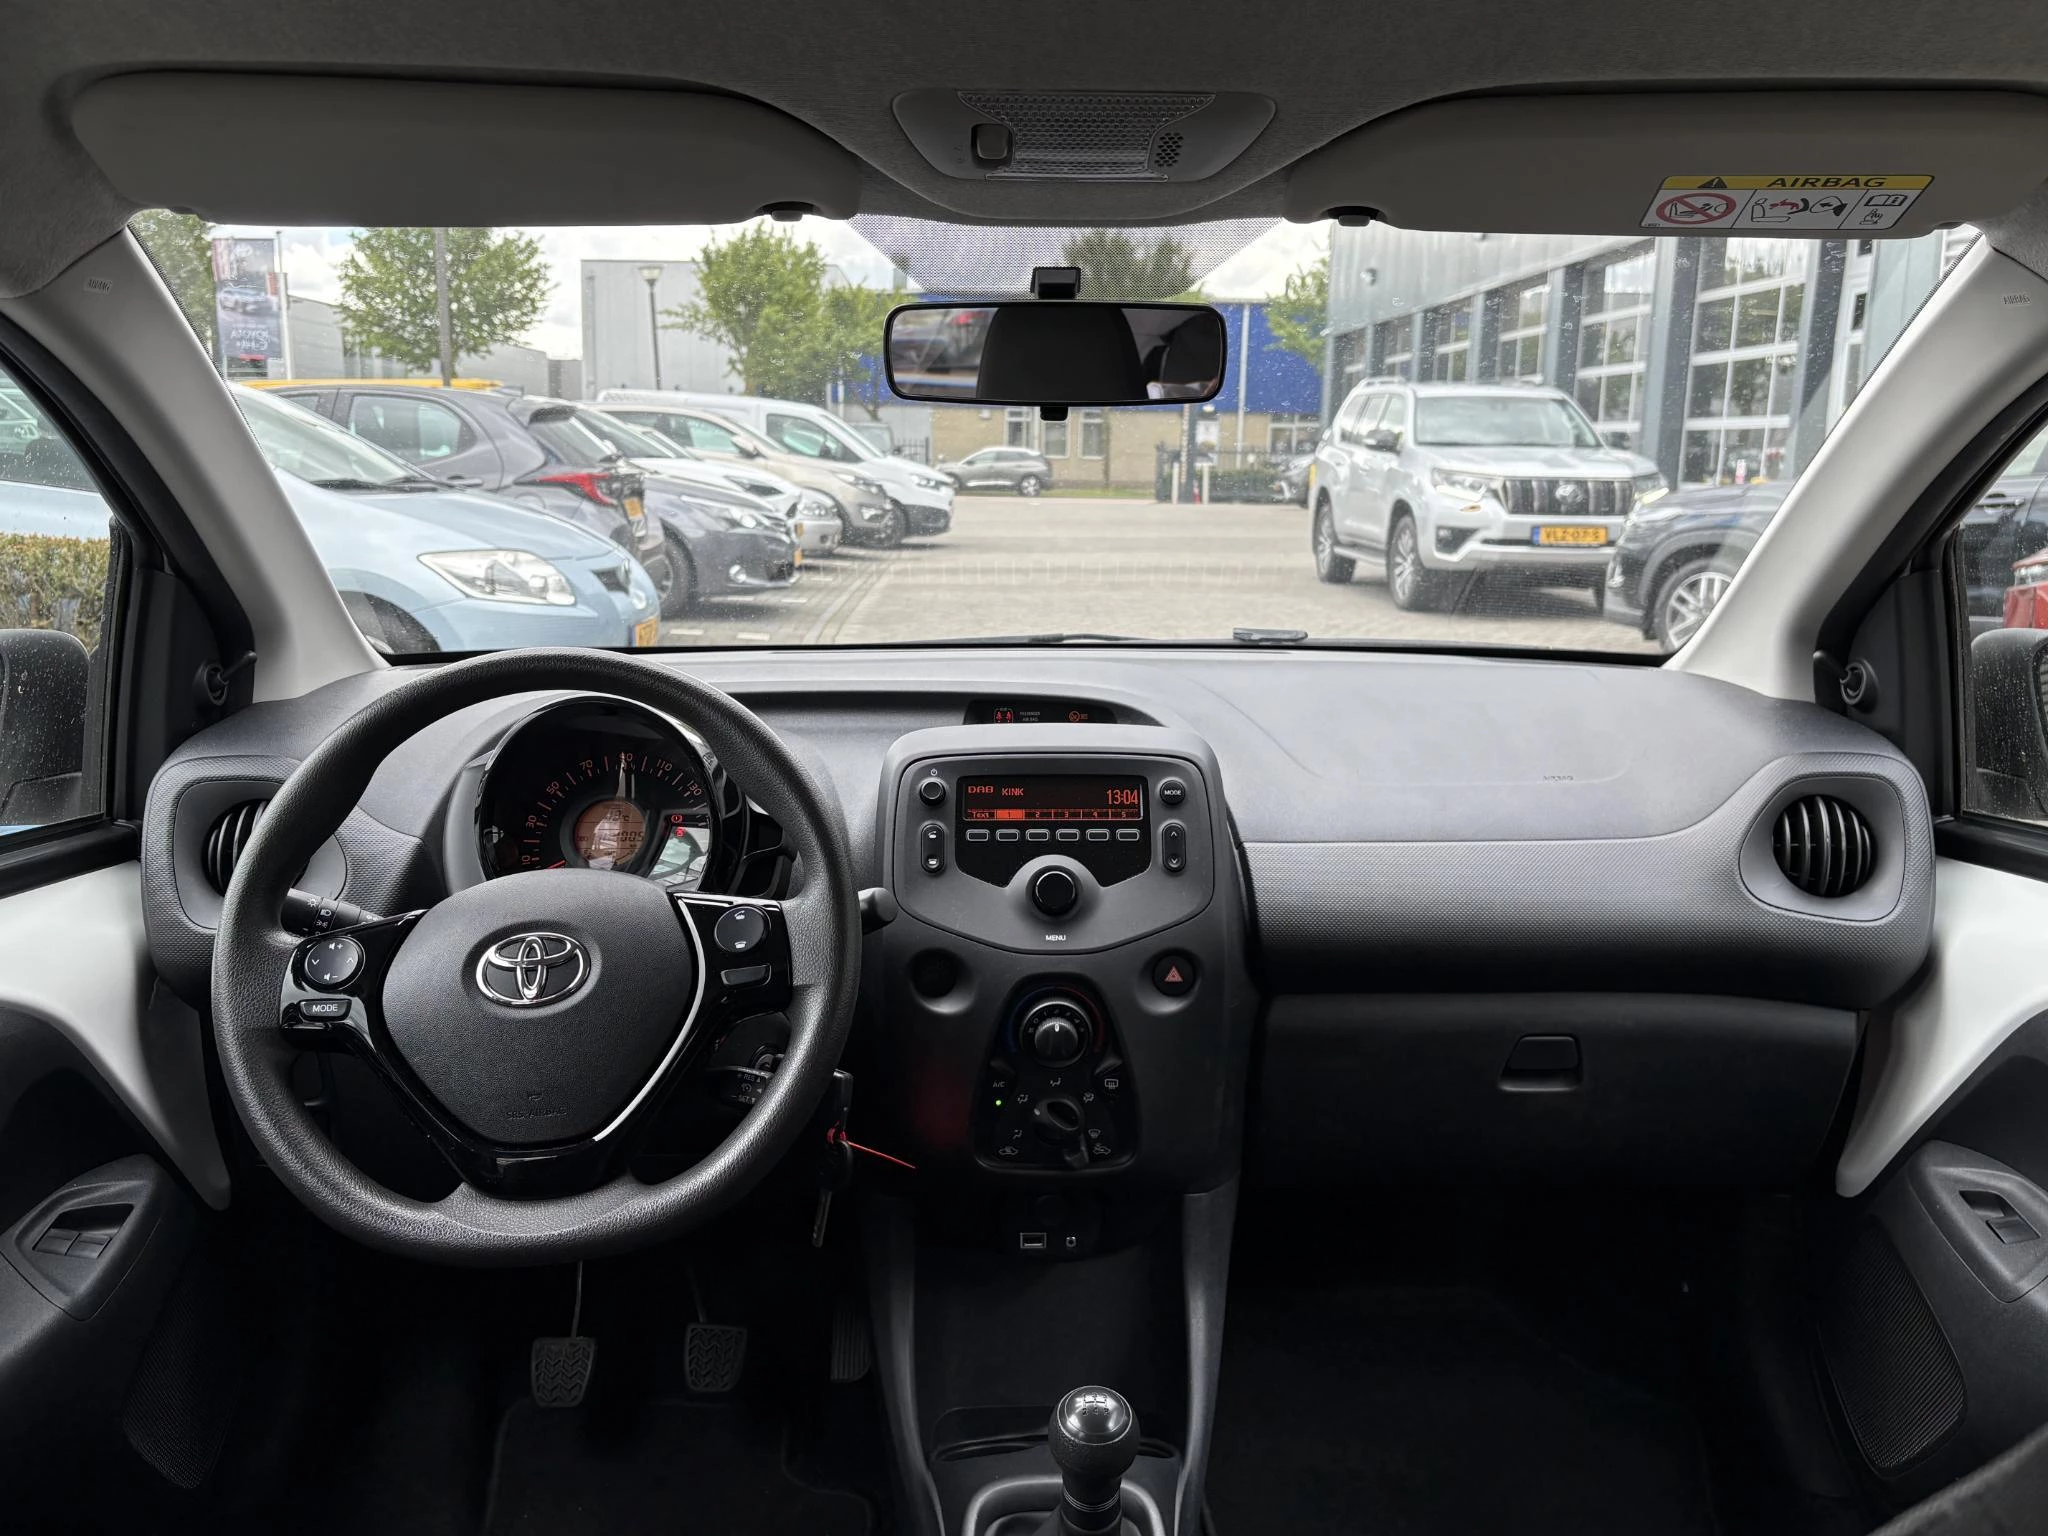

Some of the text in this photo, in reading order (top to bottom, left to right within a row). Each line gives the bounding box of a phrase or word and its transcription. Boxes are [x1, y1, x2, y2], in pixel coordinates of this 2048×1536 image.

[1766, 176, 1887, 188] AIRBAG
[578, 759, 593, 769] 70
[656, 759, 673, 771] 110
[546, 781, 560, 794] 50
[687, 779, 702, 796] 130
[967, 785, 1139, 805] DAB KINK 13:04
[526, 814, 537, 828] 30
[521, 854, 531, 865] 10
[312, 1003, 339, 1013] MODE
[743, 1073, 755, 1082] RES
